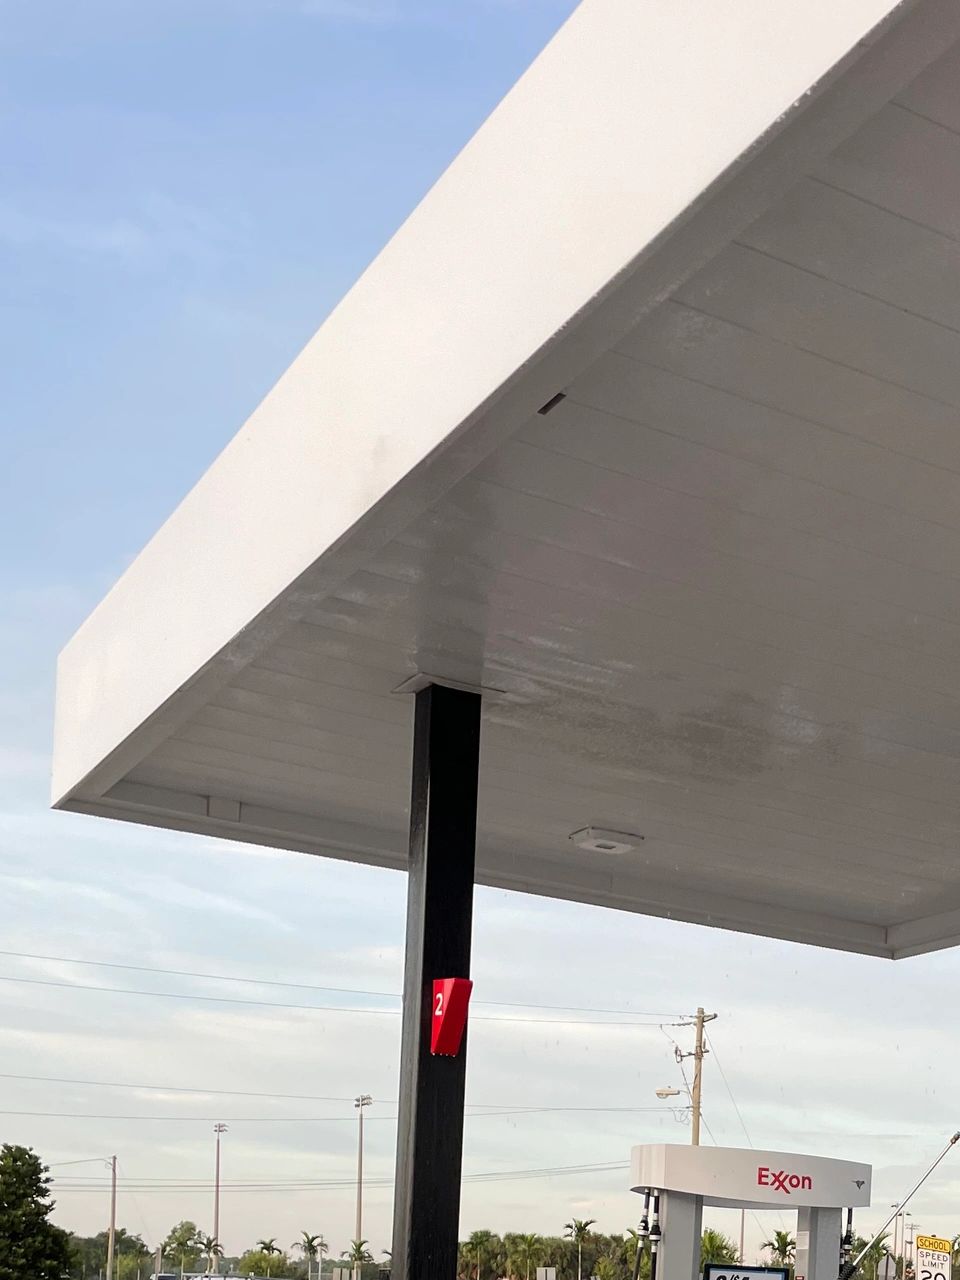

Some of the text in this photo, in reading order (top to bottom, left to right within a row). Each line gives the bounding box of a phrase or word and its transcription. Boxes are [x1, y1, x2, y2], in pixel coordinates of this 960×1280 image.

[434, 992, 444, 1016] 2
[757, 1167, 812, 1195] Exxon
[919, 1238, 948, 1251] SCHOOL
[919, 1250, 948, 1262] SPEED
[922, 1260, 945, 1269] LIMIT
